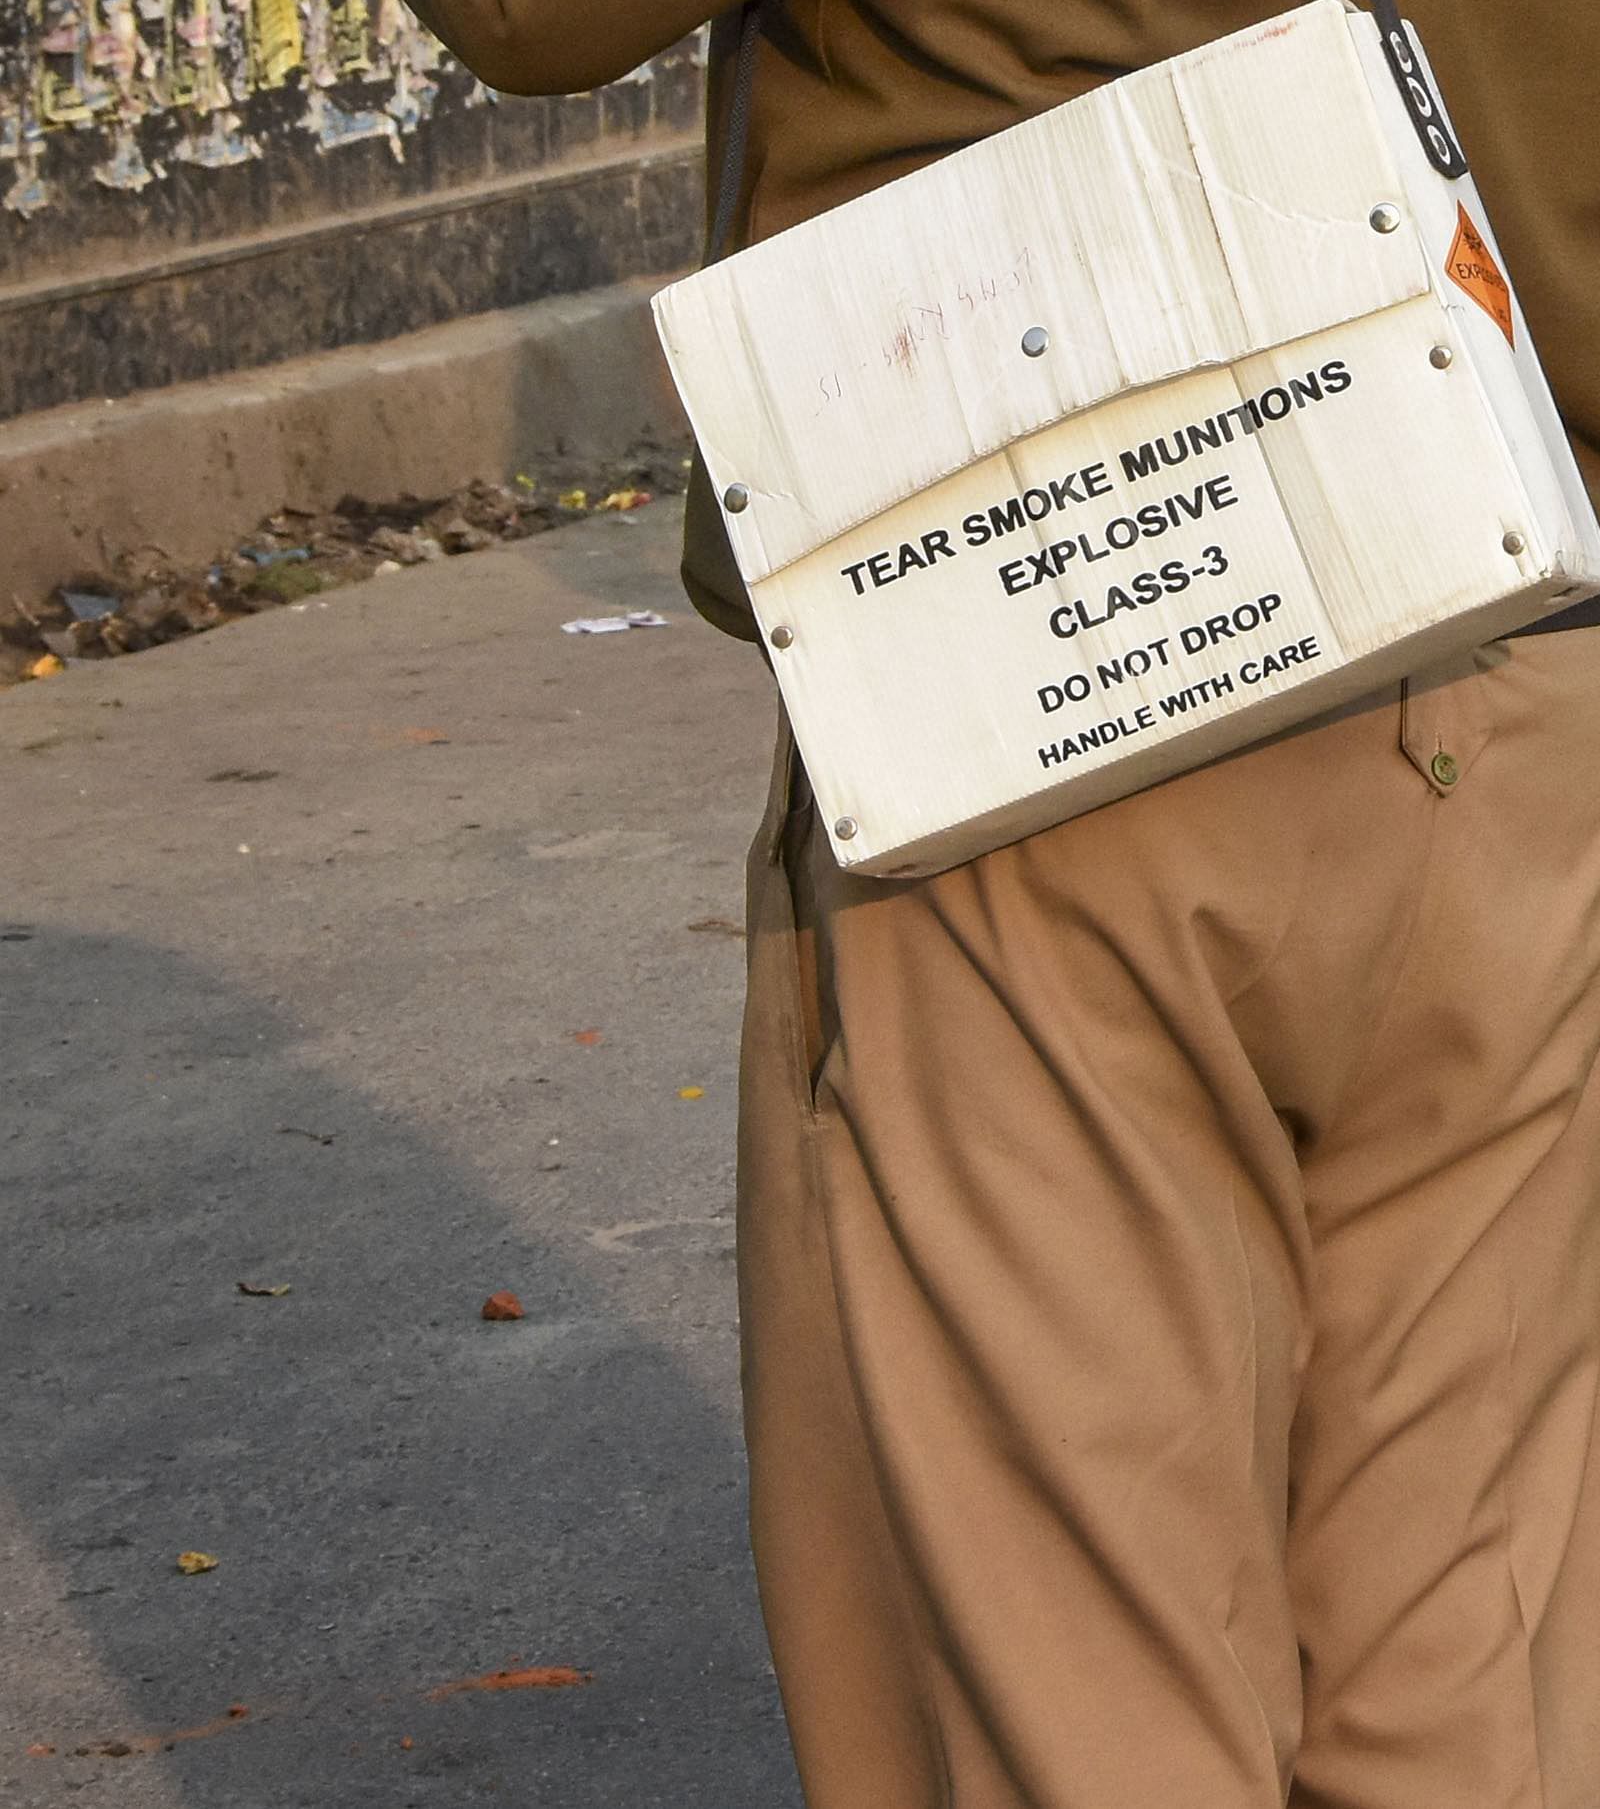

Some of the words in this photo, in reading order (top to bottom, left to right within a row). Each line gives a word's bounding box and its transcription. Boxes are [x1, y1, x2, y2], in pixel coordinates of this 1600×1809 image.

[842, 528, 957, 596] TEAR
[962, 462, 1113, 548] SMOKE
[1119, 360, 1352, 482] MUNITIONS
[999, 475, 1239, 596] EXPLOSIVE
[1049, 545, 1229, 639] CLASS-3
[1037, 674, 1091, 714] DO
[1097, 638, 1170, 689] NOT
[1180, 594, 1282, 655] DROP
[1037, 706, 1156, 768] HANDLE
[1159, 673, 1235, 718] WITH
[1239, 636, 1321, 685] CARE
